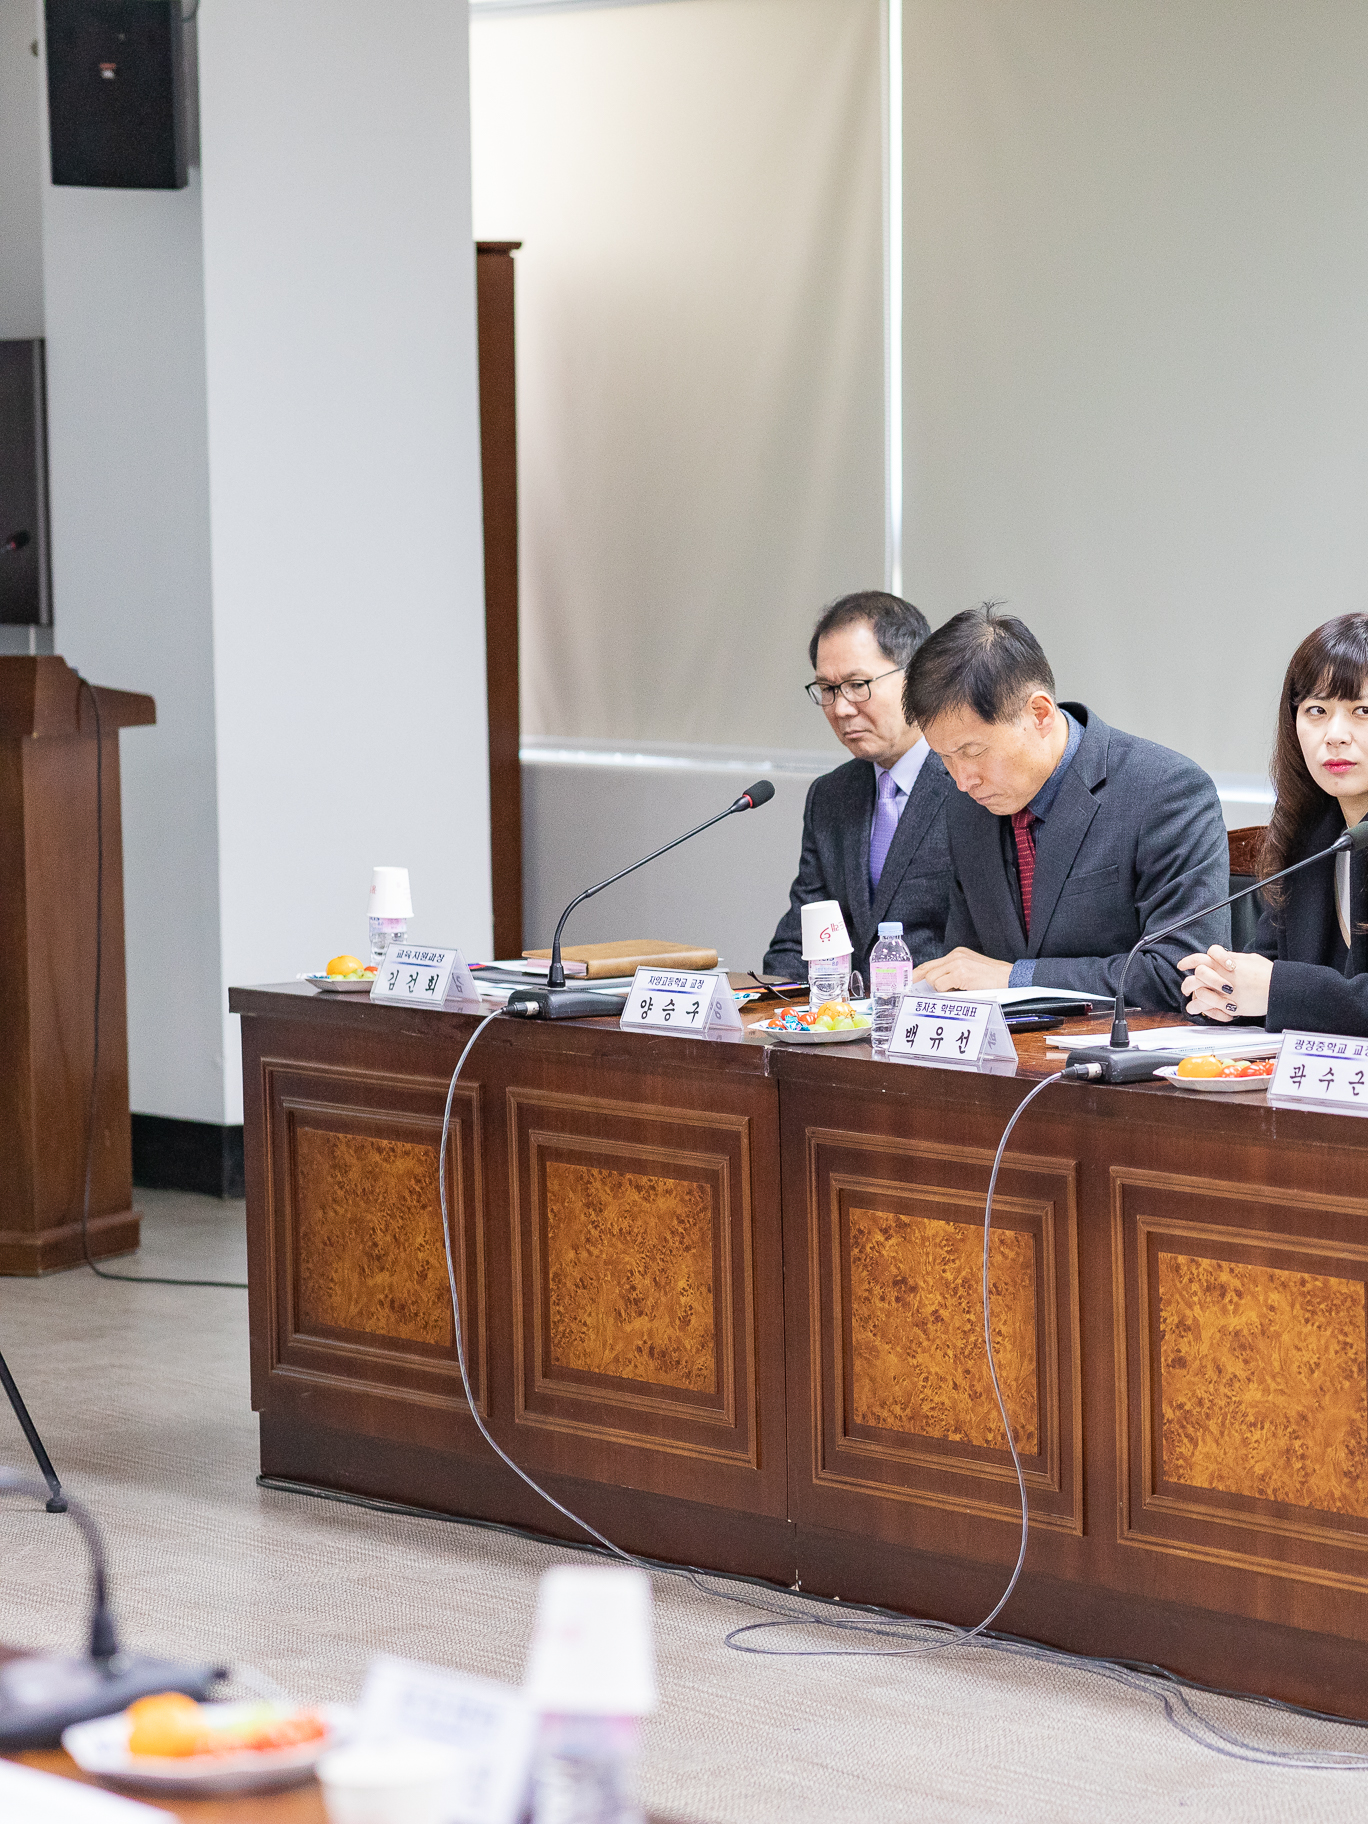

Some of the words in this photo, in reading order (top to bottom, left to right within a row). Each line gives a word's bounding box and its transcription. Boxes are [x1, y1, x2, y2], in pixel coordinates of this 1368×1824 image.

[396, 949, 445, 963] 교육지원과장
[648, 975, 688, 988] 자양고등학교
[689, 978, 705, 990] 교장
[915, 1001, 938, 1014] 동자초
[940, 1003, 978, 1018] 학부모대표
[1294, 1039, 1348, 1055] 광장중학교
